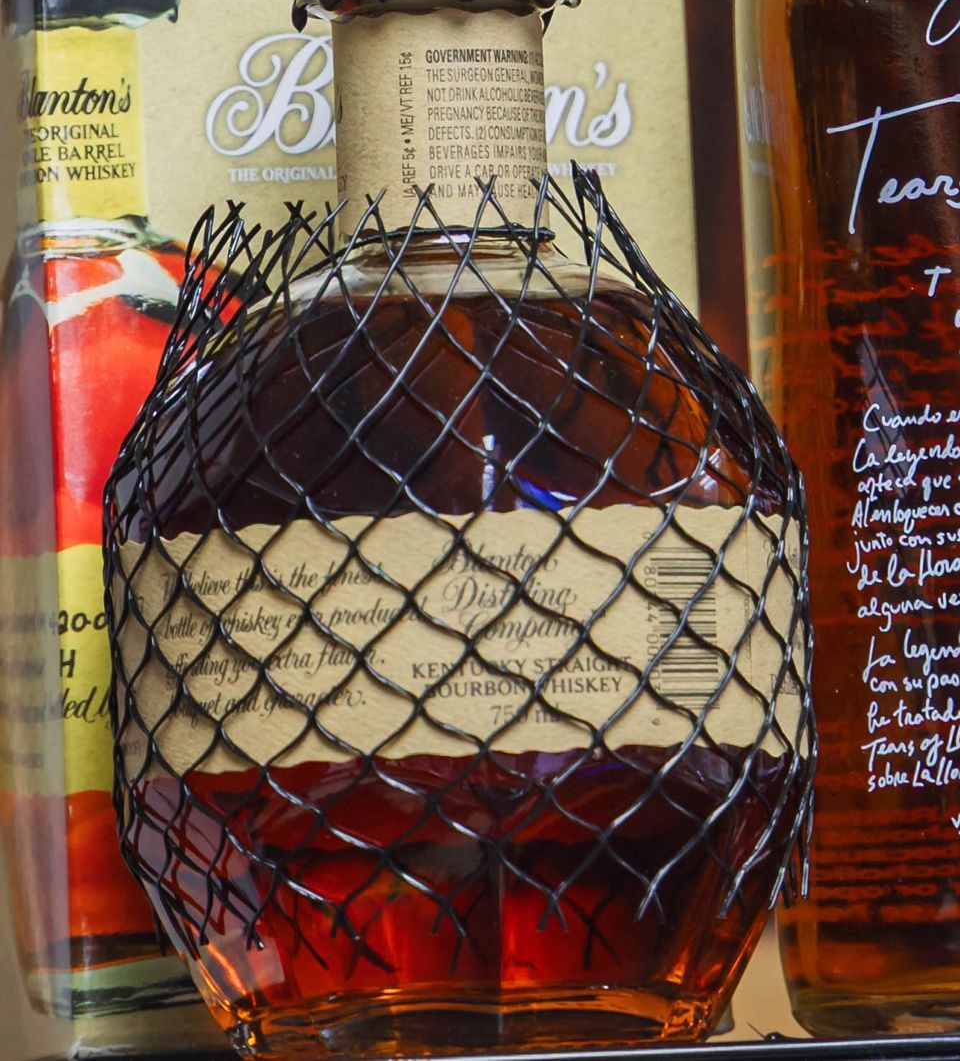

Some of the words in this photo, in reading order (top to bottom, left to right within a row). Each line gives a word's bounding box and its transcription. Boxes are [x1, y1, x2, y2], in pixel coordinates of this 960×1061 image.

[425, 48, 492, 64] GOVERNMENT
[399, 74, 413, 96] REF
[426, 68, 446, 82] THE
[447, 67, 493, 82] SURGEON
[427, 87, 446, 102] NOT
[448, 86, 476, 102] DRINK
[428, 106, 484, 121] PREGNANCY
[486, 106, 521, 121] BECAUSE
[38, 122, 120, 145] ORIGINAL
[58, 142, 125, 164] BARREL
[429, 144, 490, 160] BEVERAGES
[67, 161, 137, 181] WHISKEY
[227, 168, 259, 182] THE
[402, 162, 416, 188] REF
[430, 164, 461, 179] DRIVE
[464, 164, 471, 178] A
[497, 163, 510, 179] OR
[863, 403, 942, 432] Cuando
[858, 472, 917, 502] azteca
[922, 474, 951, 502] que
[847, 529, 894, 574] junto
[898, 534, 932, 548] con
[857, 563, 883, 591] de
[886, 552, 916, 587] la
[857, 597, 934, 632] alguna
[869, 676, 898, 693] con
[902, 676, 924, 692] su
[866, 700, 891, 734] he
[860, 736, 916, 772] Tears
[920, 733, 945, 767] of
[867, 761, 910, 793] sobre
